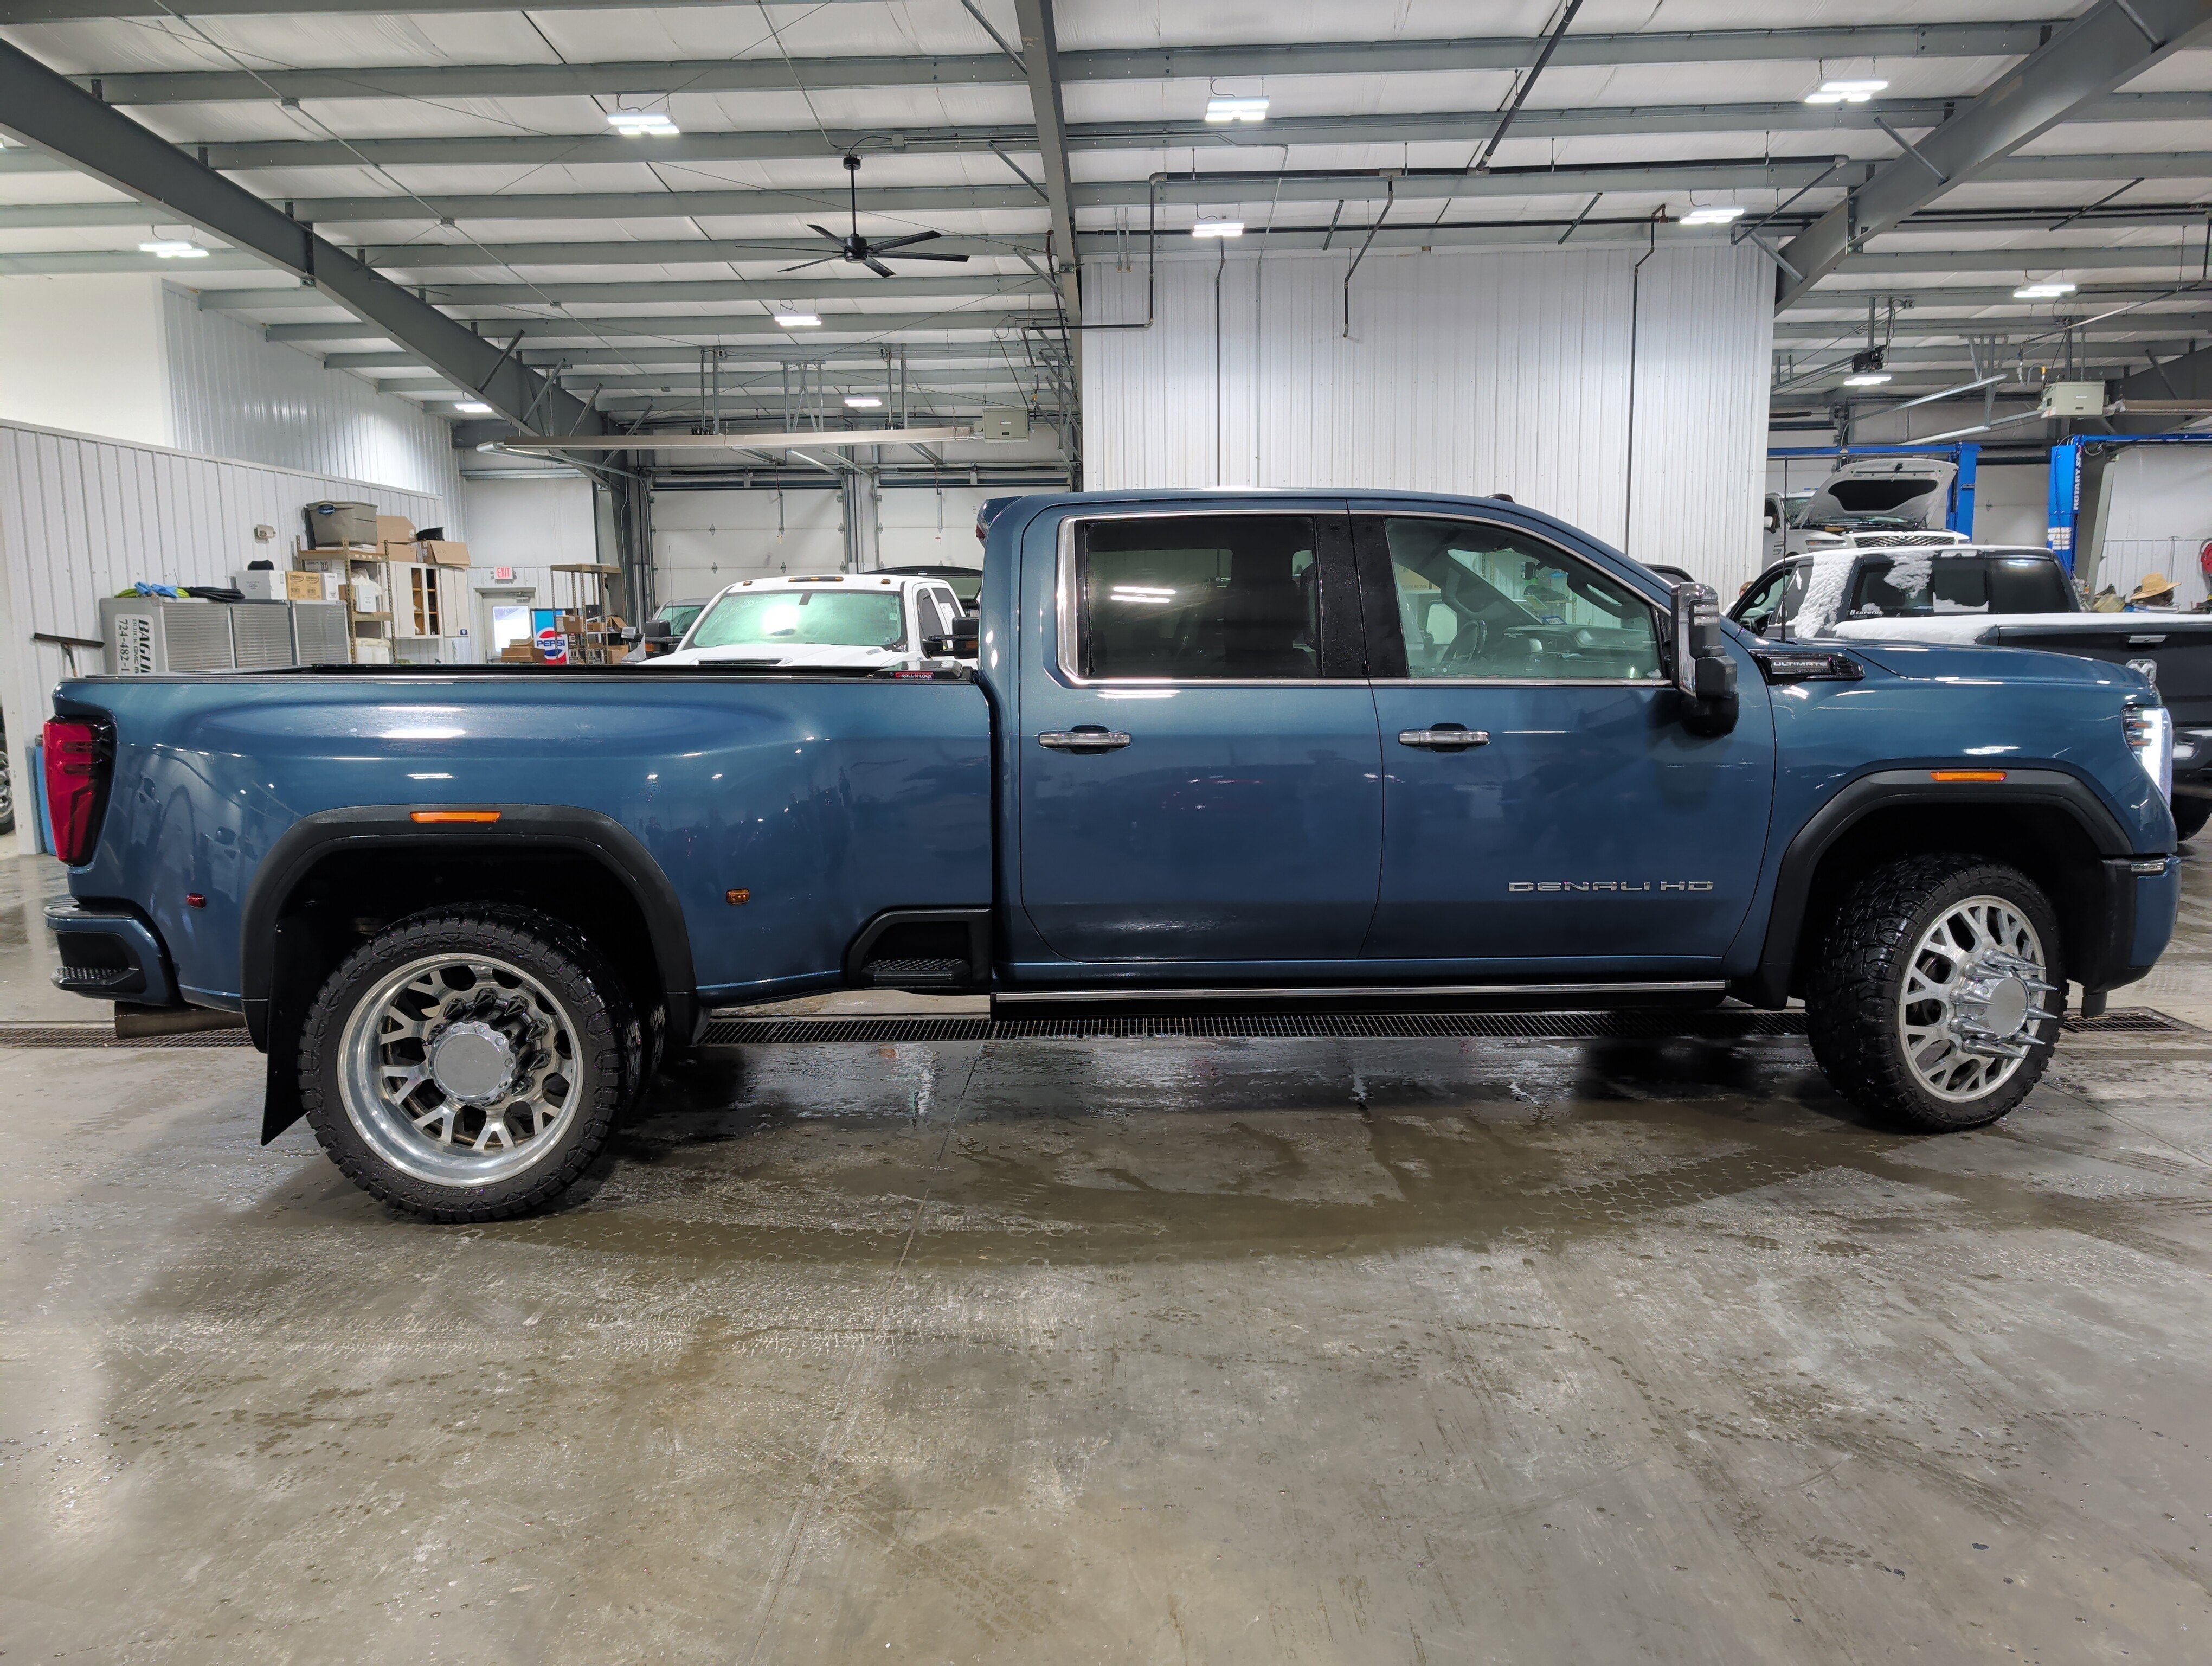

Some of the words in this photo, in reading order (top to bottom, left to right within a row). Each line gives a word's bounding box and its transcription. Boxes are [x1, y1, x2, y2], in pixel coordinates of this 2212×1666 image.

[497, 567, 510, 578] EXIT
[1508, 881, 1650, 892] DENALI
[1660, 881, 1713, 891] HD
